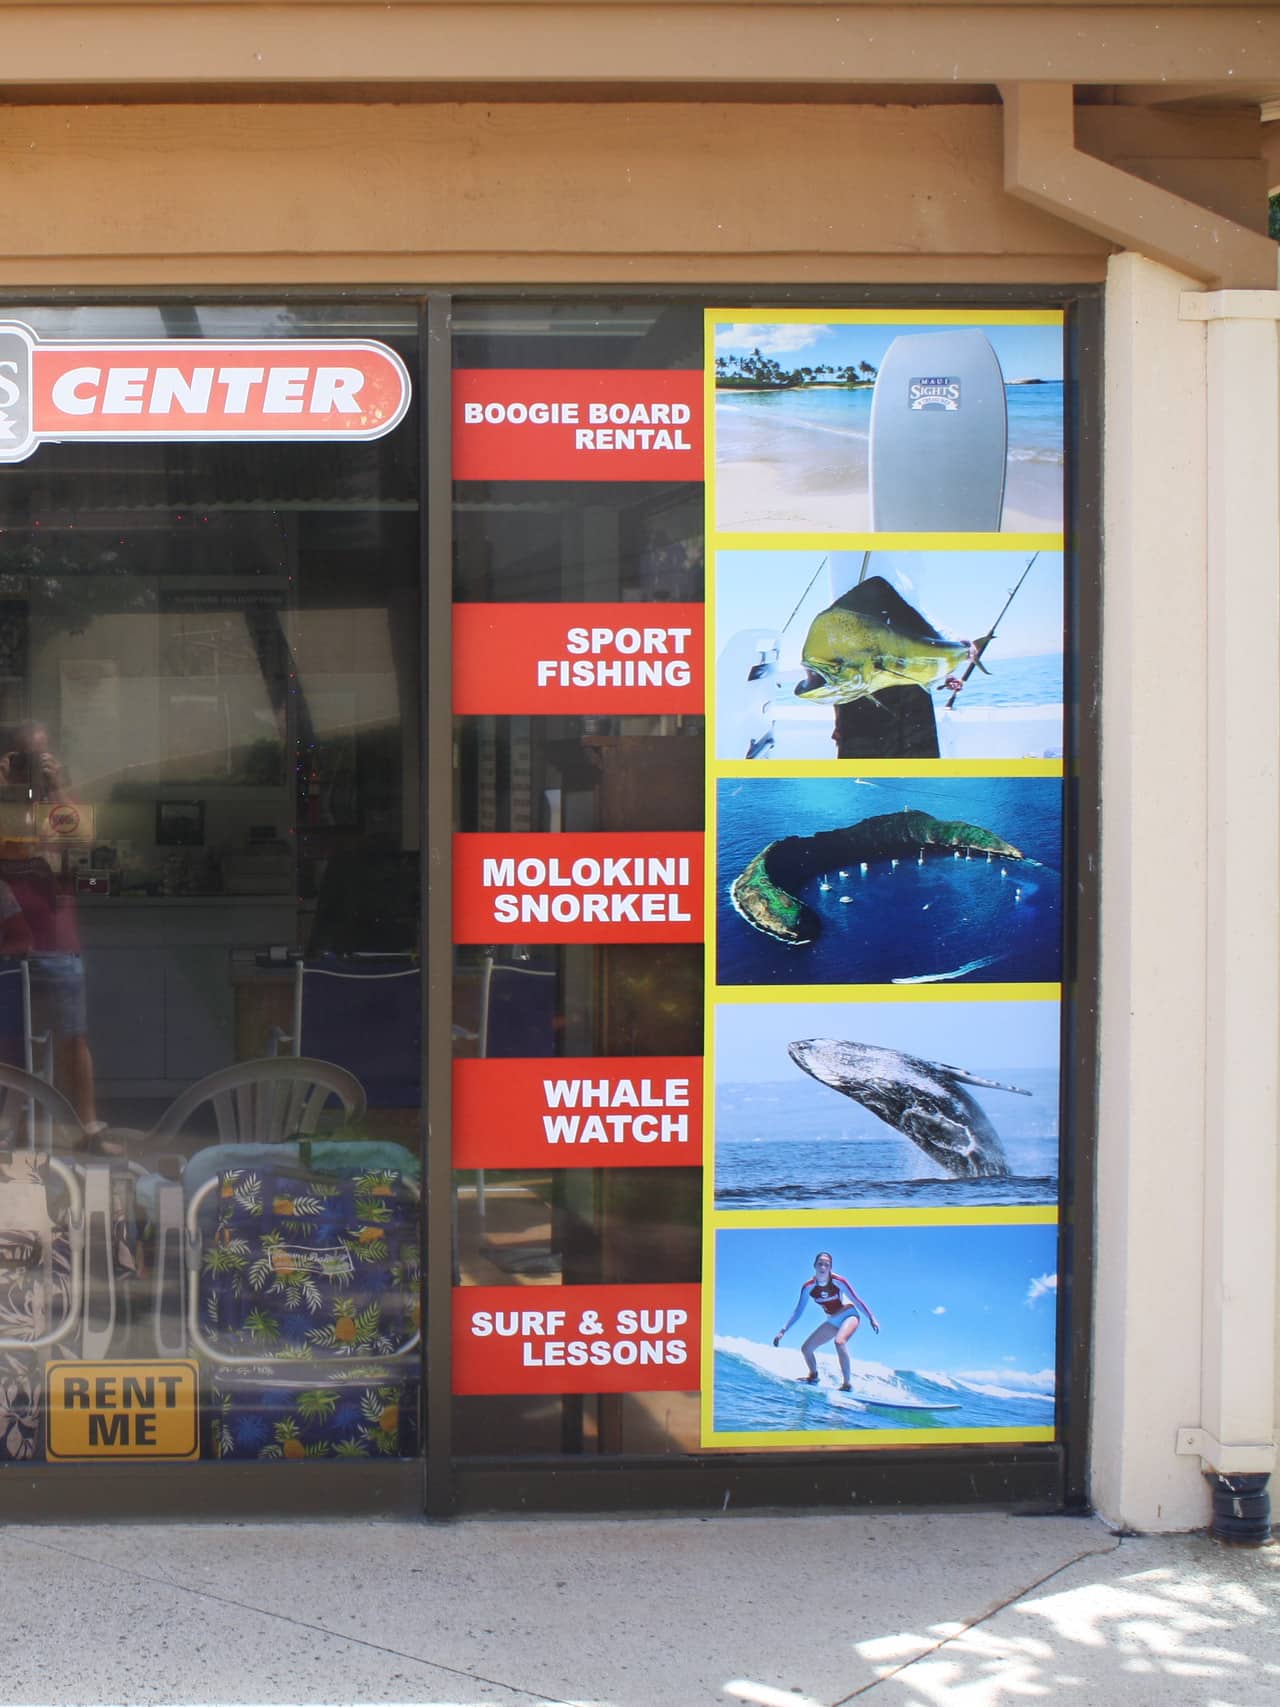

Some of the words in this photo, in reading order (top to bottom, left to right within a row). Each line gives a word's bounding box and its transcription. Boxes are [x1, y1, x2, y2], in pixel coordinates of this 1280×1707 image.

[52, 366, 363, 416] CENTER
[910, 384, 960, 400] SIGHTS
[464, 402, 580, 425] BOOGIE
[588, 402, 691, 425] BOARD
[575, 428, 692, 450] RENTAL
[566, 627, 692, 655] SPORT
[537, 660, 691, 687] FISHING
[483, 857, 689, 887] MOLOKINI
[493, 893, 692, 923] SNORKEL
[543, 1078, 690, 1108] WHALE
[542, 1114, 689, 1144] WATCH
[471, 1309, 566, 1337] SURF
[578, 1309, 604, 1337] &
[616, 1309, 688, 1337] SUP
[523, 1339, 688, 1367] LESSONS
[63, 1376, 183, 1410] RENT
[88, 1413, 157, 1446] ME
